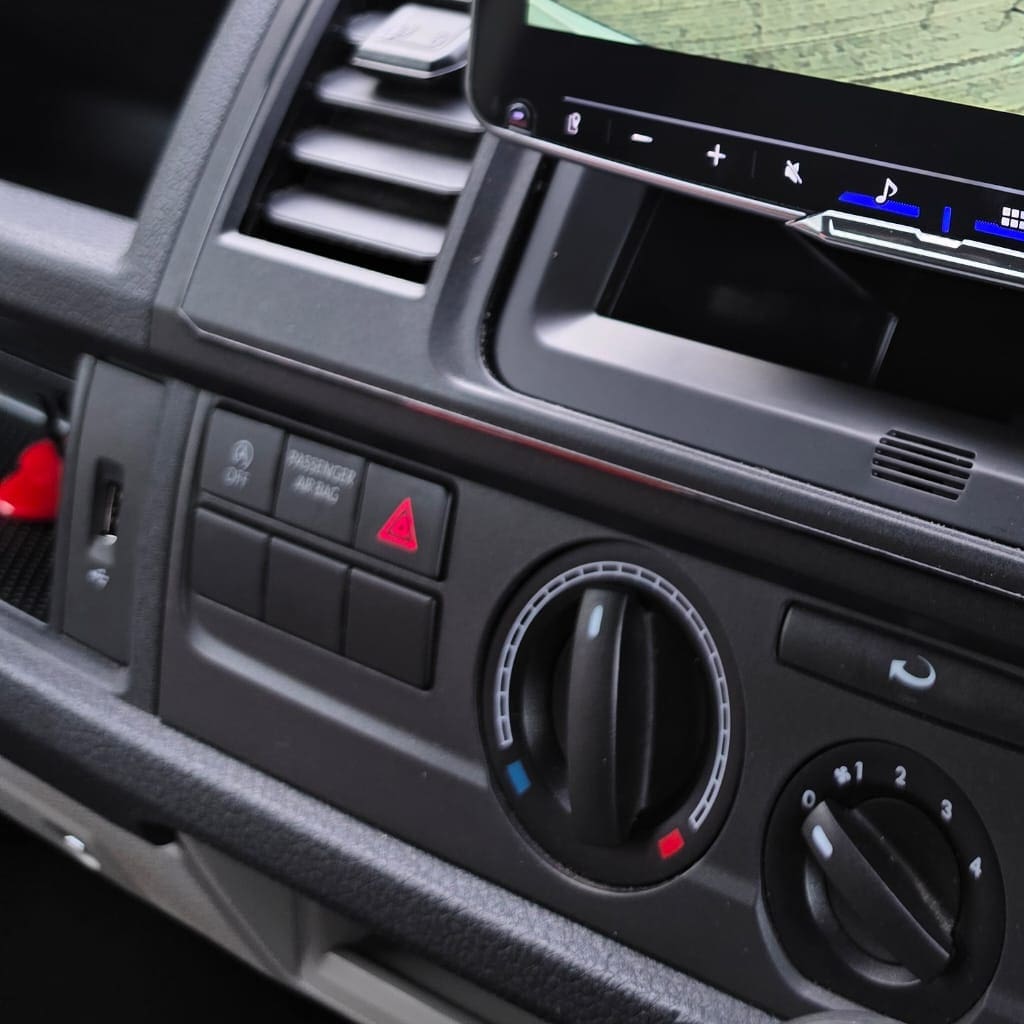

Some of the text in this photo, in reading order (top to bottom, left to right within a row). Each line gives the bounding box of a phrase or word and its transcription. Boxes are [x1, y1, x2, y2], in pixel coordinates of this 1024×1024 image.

[222, 466, 250, 488] OFF
[286, 448, 357, 486] PASSENGER
[854, 761, 864, 781] 1
[895, 765, 907, 787] 2
[802, 789, 816, 810] 0
[940, 799, 953, 821] 3
[969, 856, 982, 879] 4
